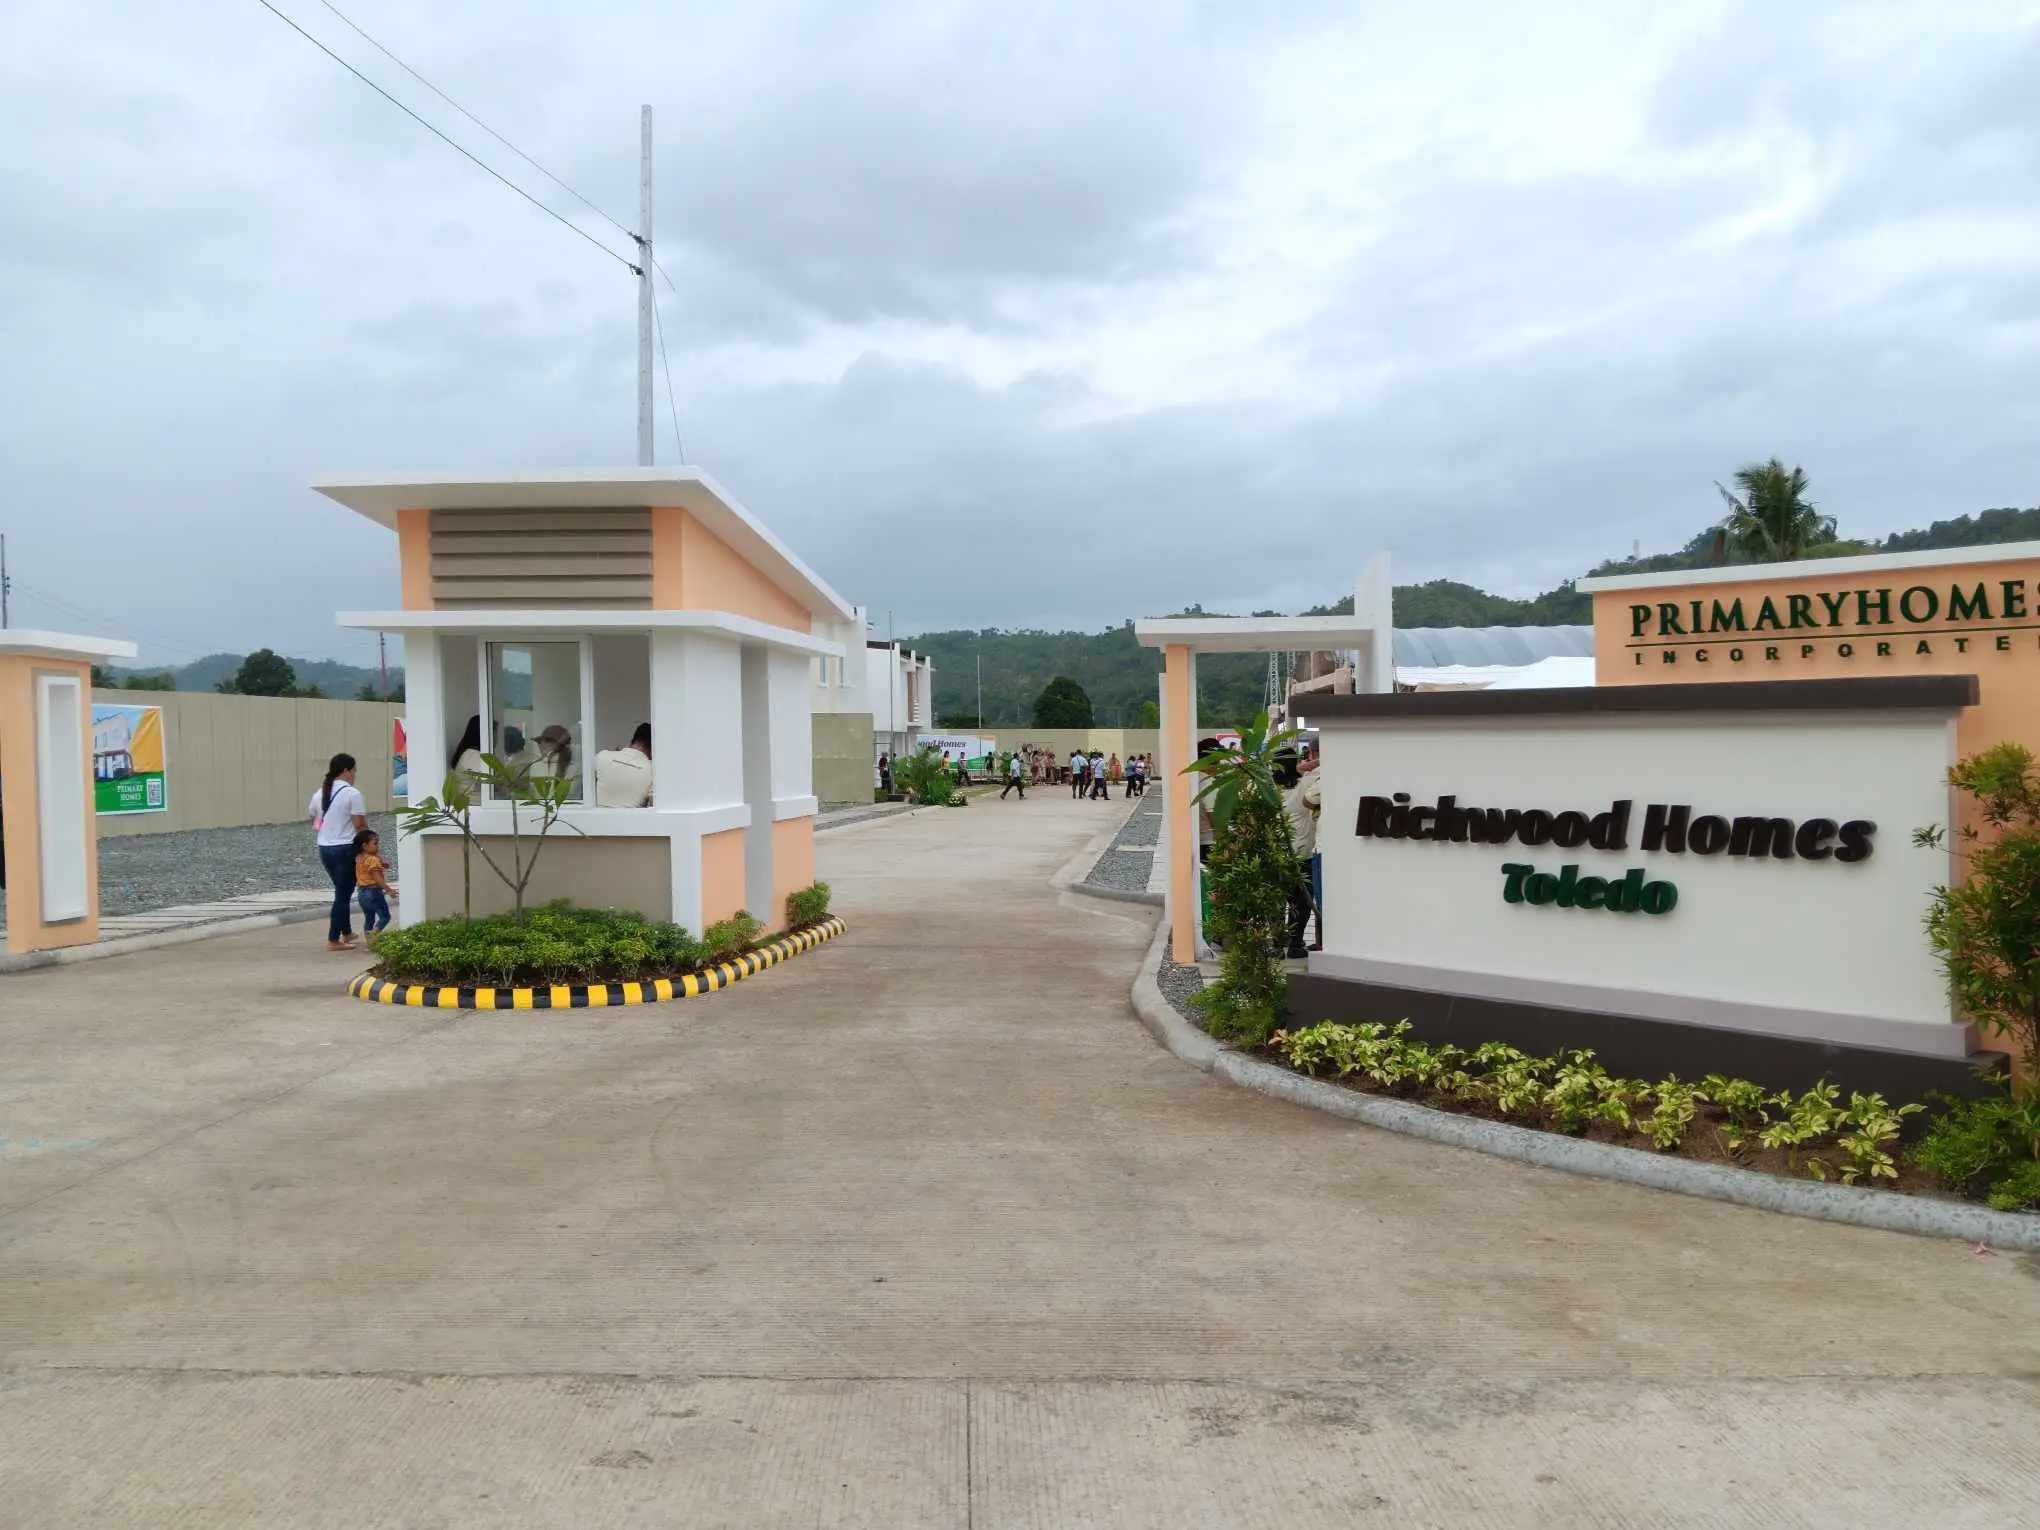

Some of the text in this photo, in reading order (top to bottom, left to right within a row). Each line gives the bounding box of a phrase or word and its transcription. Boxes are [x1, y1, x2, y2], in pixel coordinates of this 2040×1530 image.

[1629, 579, 2040, 637] PRIMARYHOME
[1634, 634, 2040, 666] INCORPORATE
[1355, 792, 1878, 864] Richwood Homes
[1501, 862, 1680, 916] Toledo
